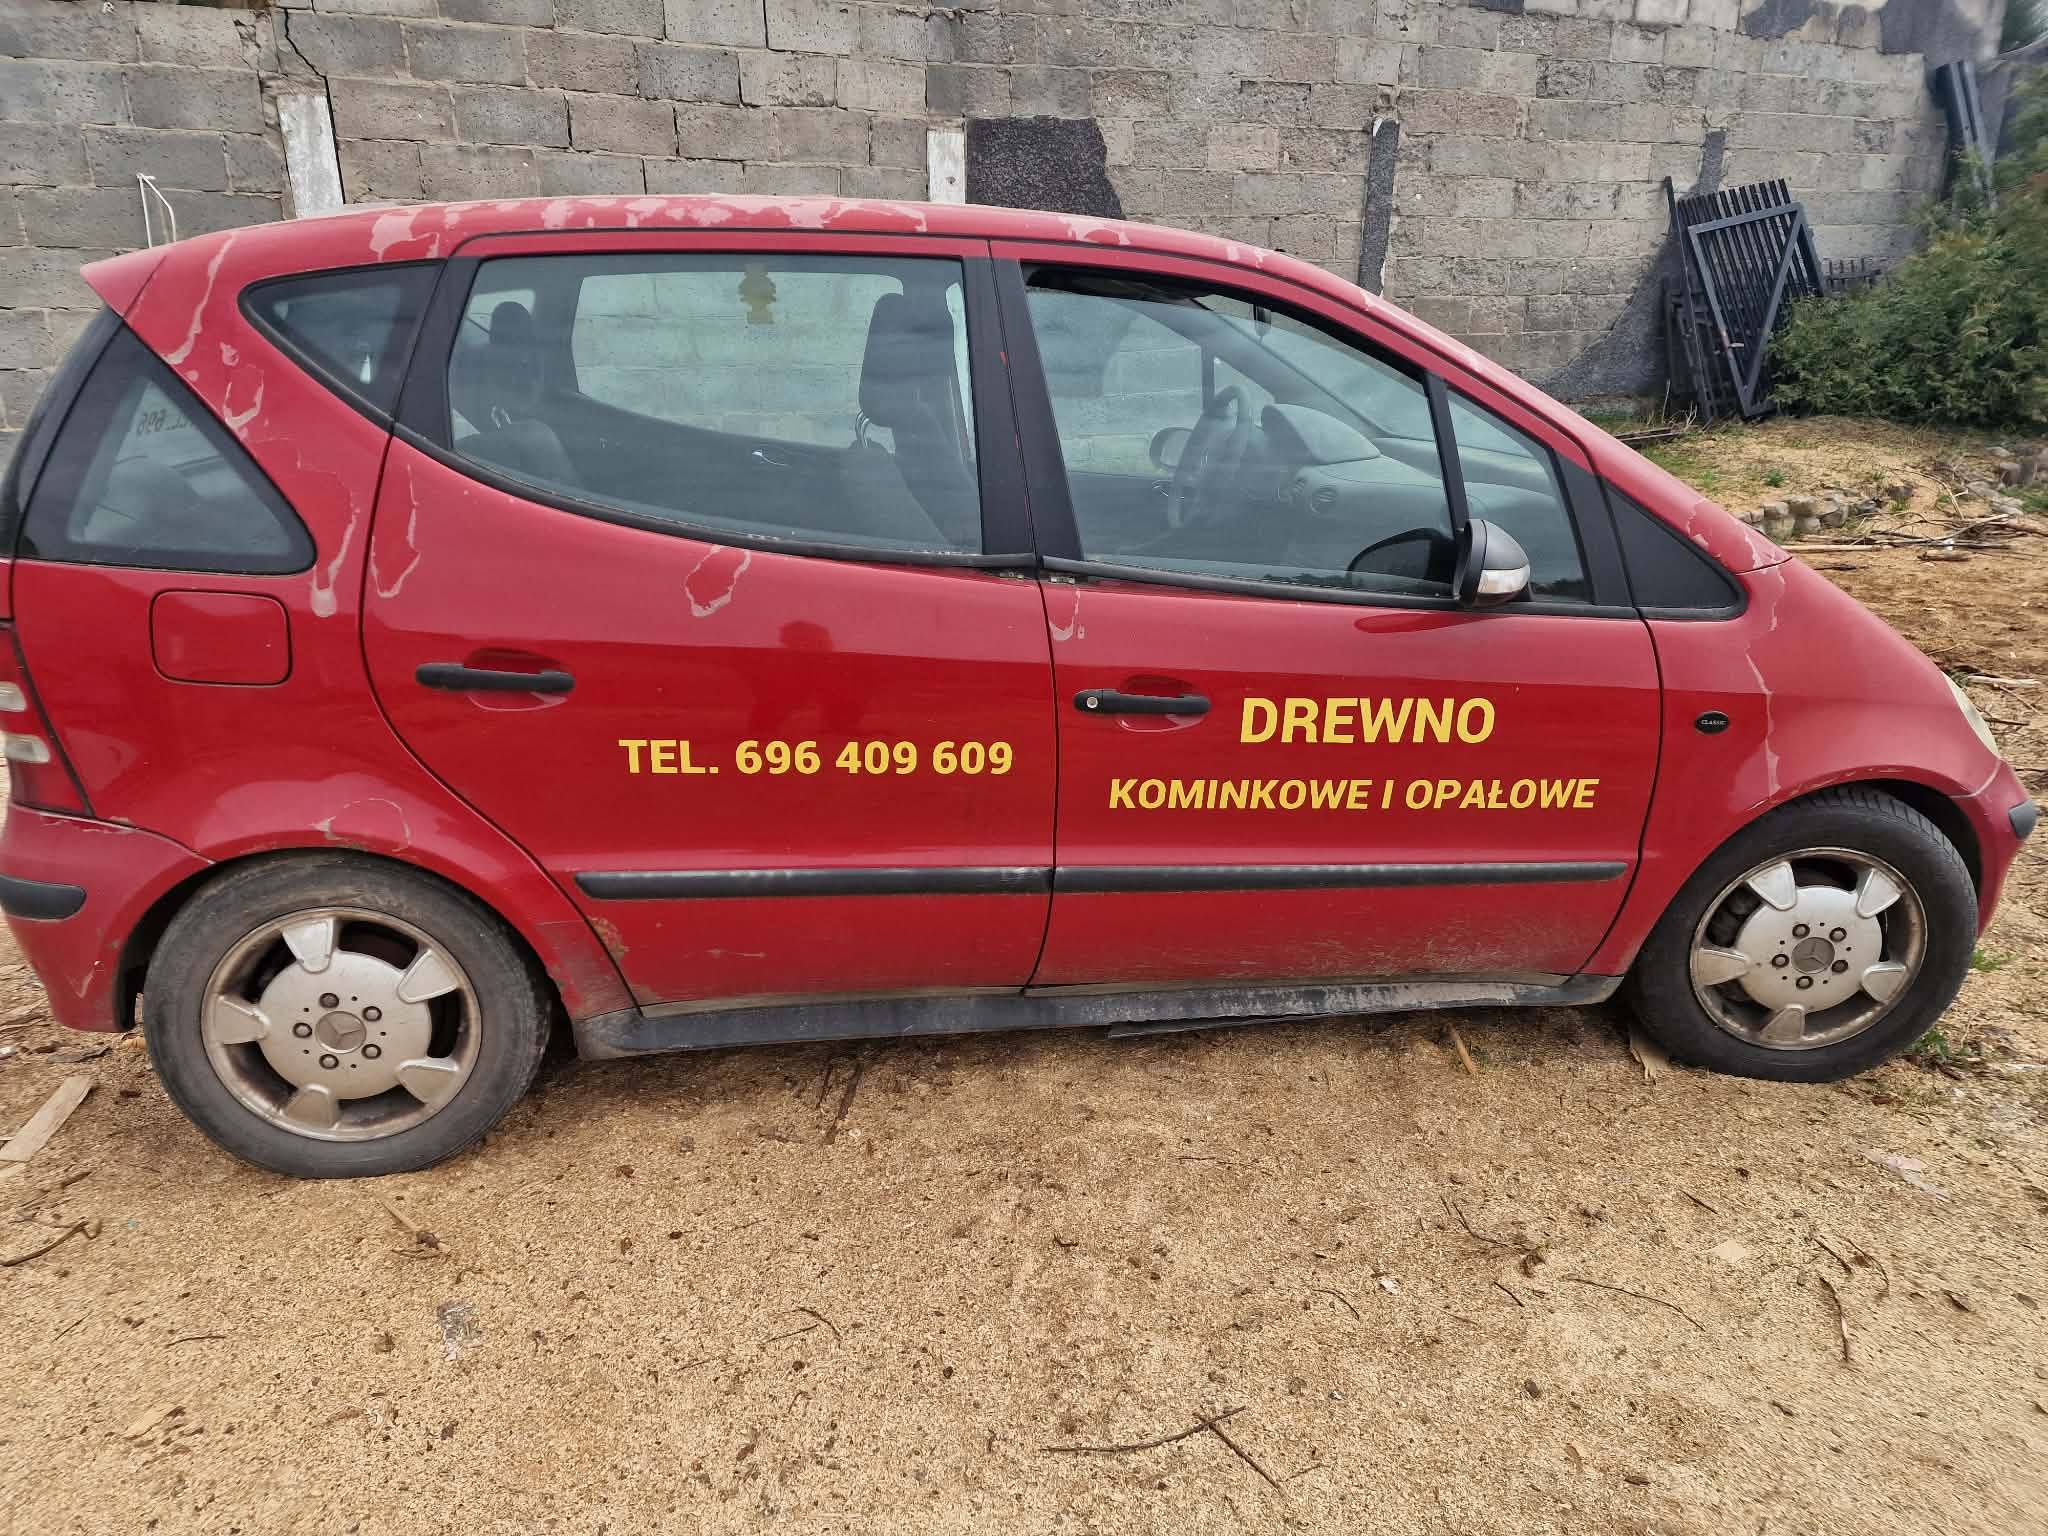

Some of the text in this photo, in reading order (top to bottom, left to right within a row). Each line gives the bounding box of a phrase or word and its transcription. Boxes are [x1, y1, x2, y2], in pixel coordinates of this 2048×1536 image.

[1241, 698, 1495, 744] DREWNO
[619, 739, 1013, 775] TEL. 696 409 609
[1109, 779, 1600, 809] KOMINKOWE I OPAŁOWE
